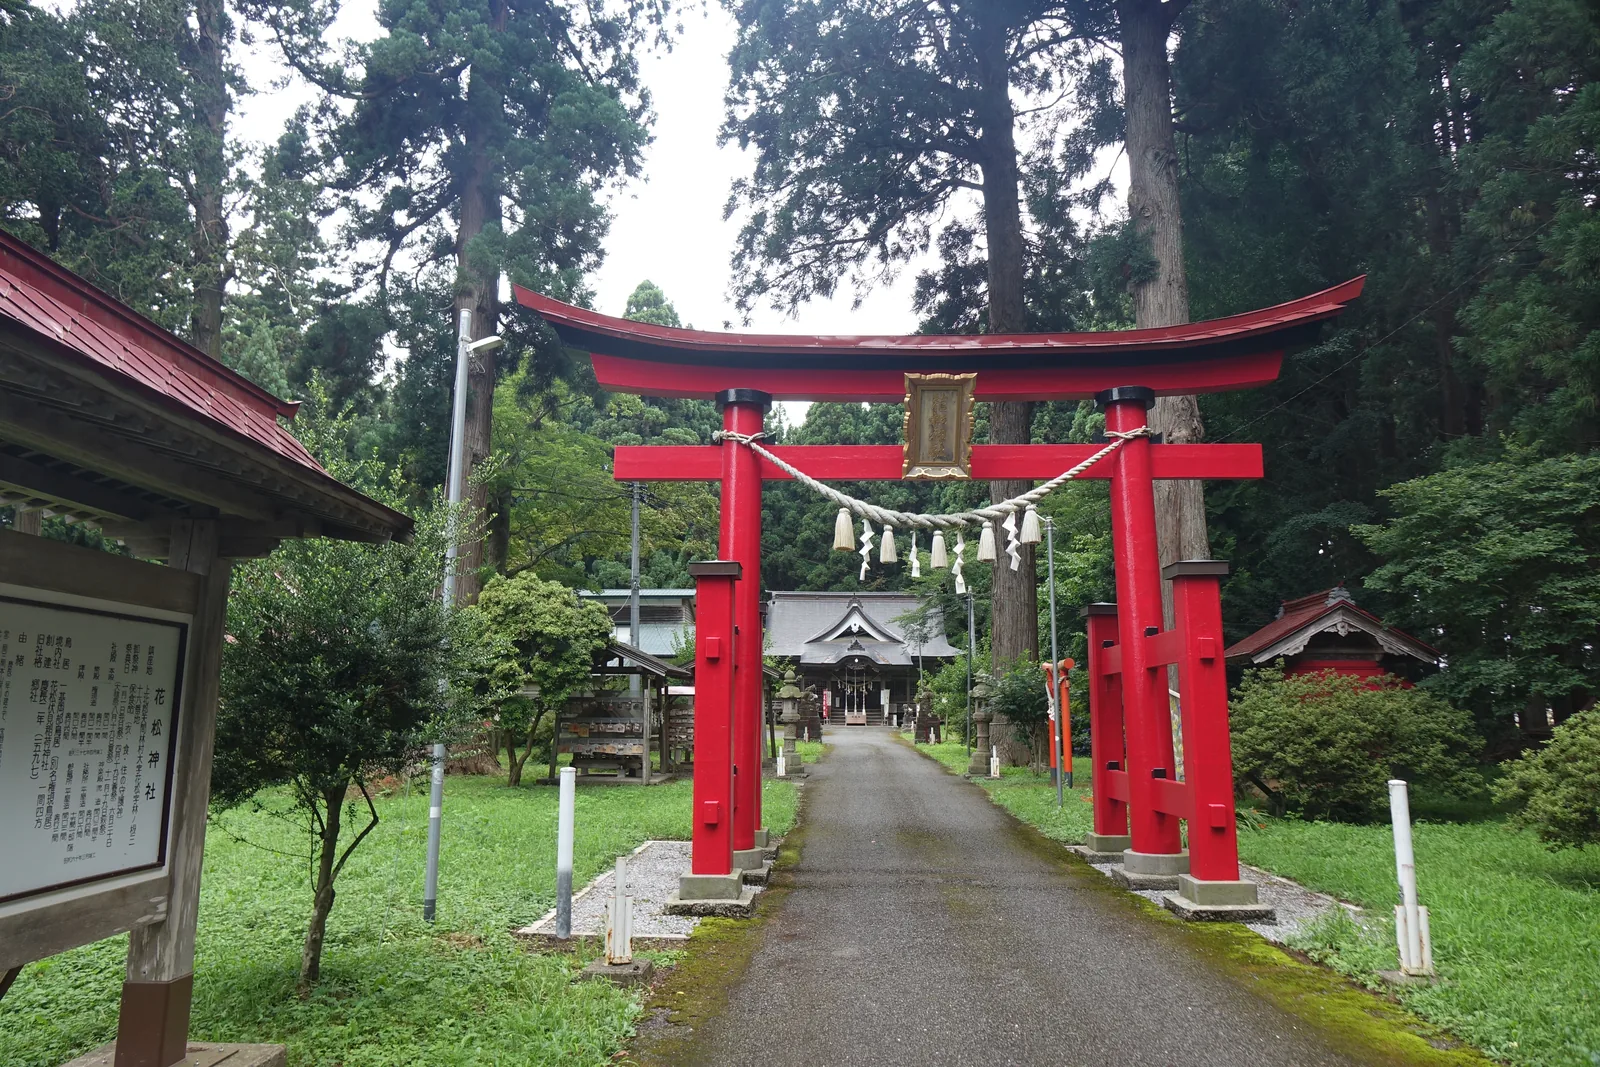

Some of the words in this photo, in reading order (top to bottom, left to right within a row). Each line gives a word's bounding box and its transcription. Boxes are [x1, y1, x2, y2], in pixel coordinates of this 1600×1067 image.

[16, 632, 28, 667] 由緒
[34, 634, 45, 668] 旧社格
[44, 635, 55, 669] 創建
[53, 636, 64, 670] 境内社
[63, 637, 72, 670] 鳥居
[145, 688, 166, 800] 花松神社
[35, 786, 46, 829] 一間四方
